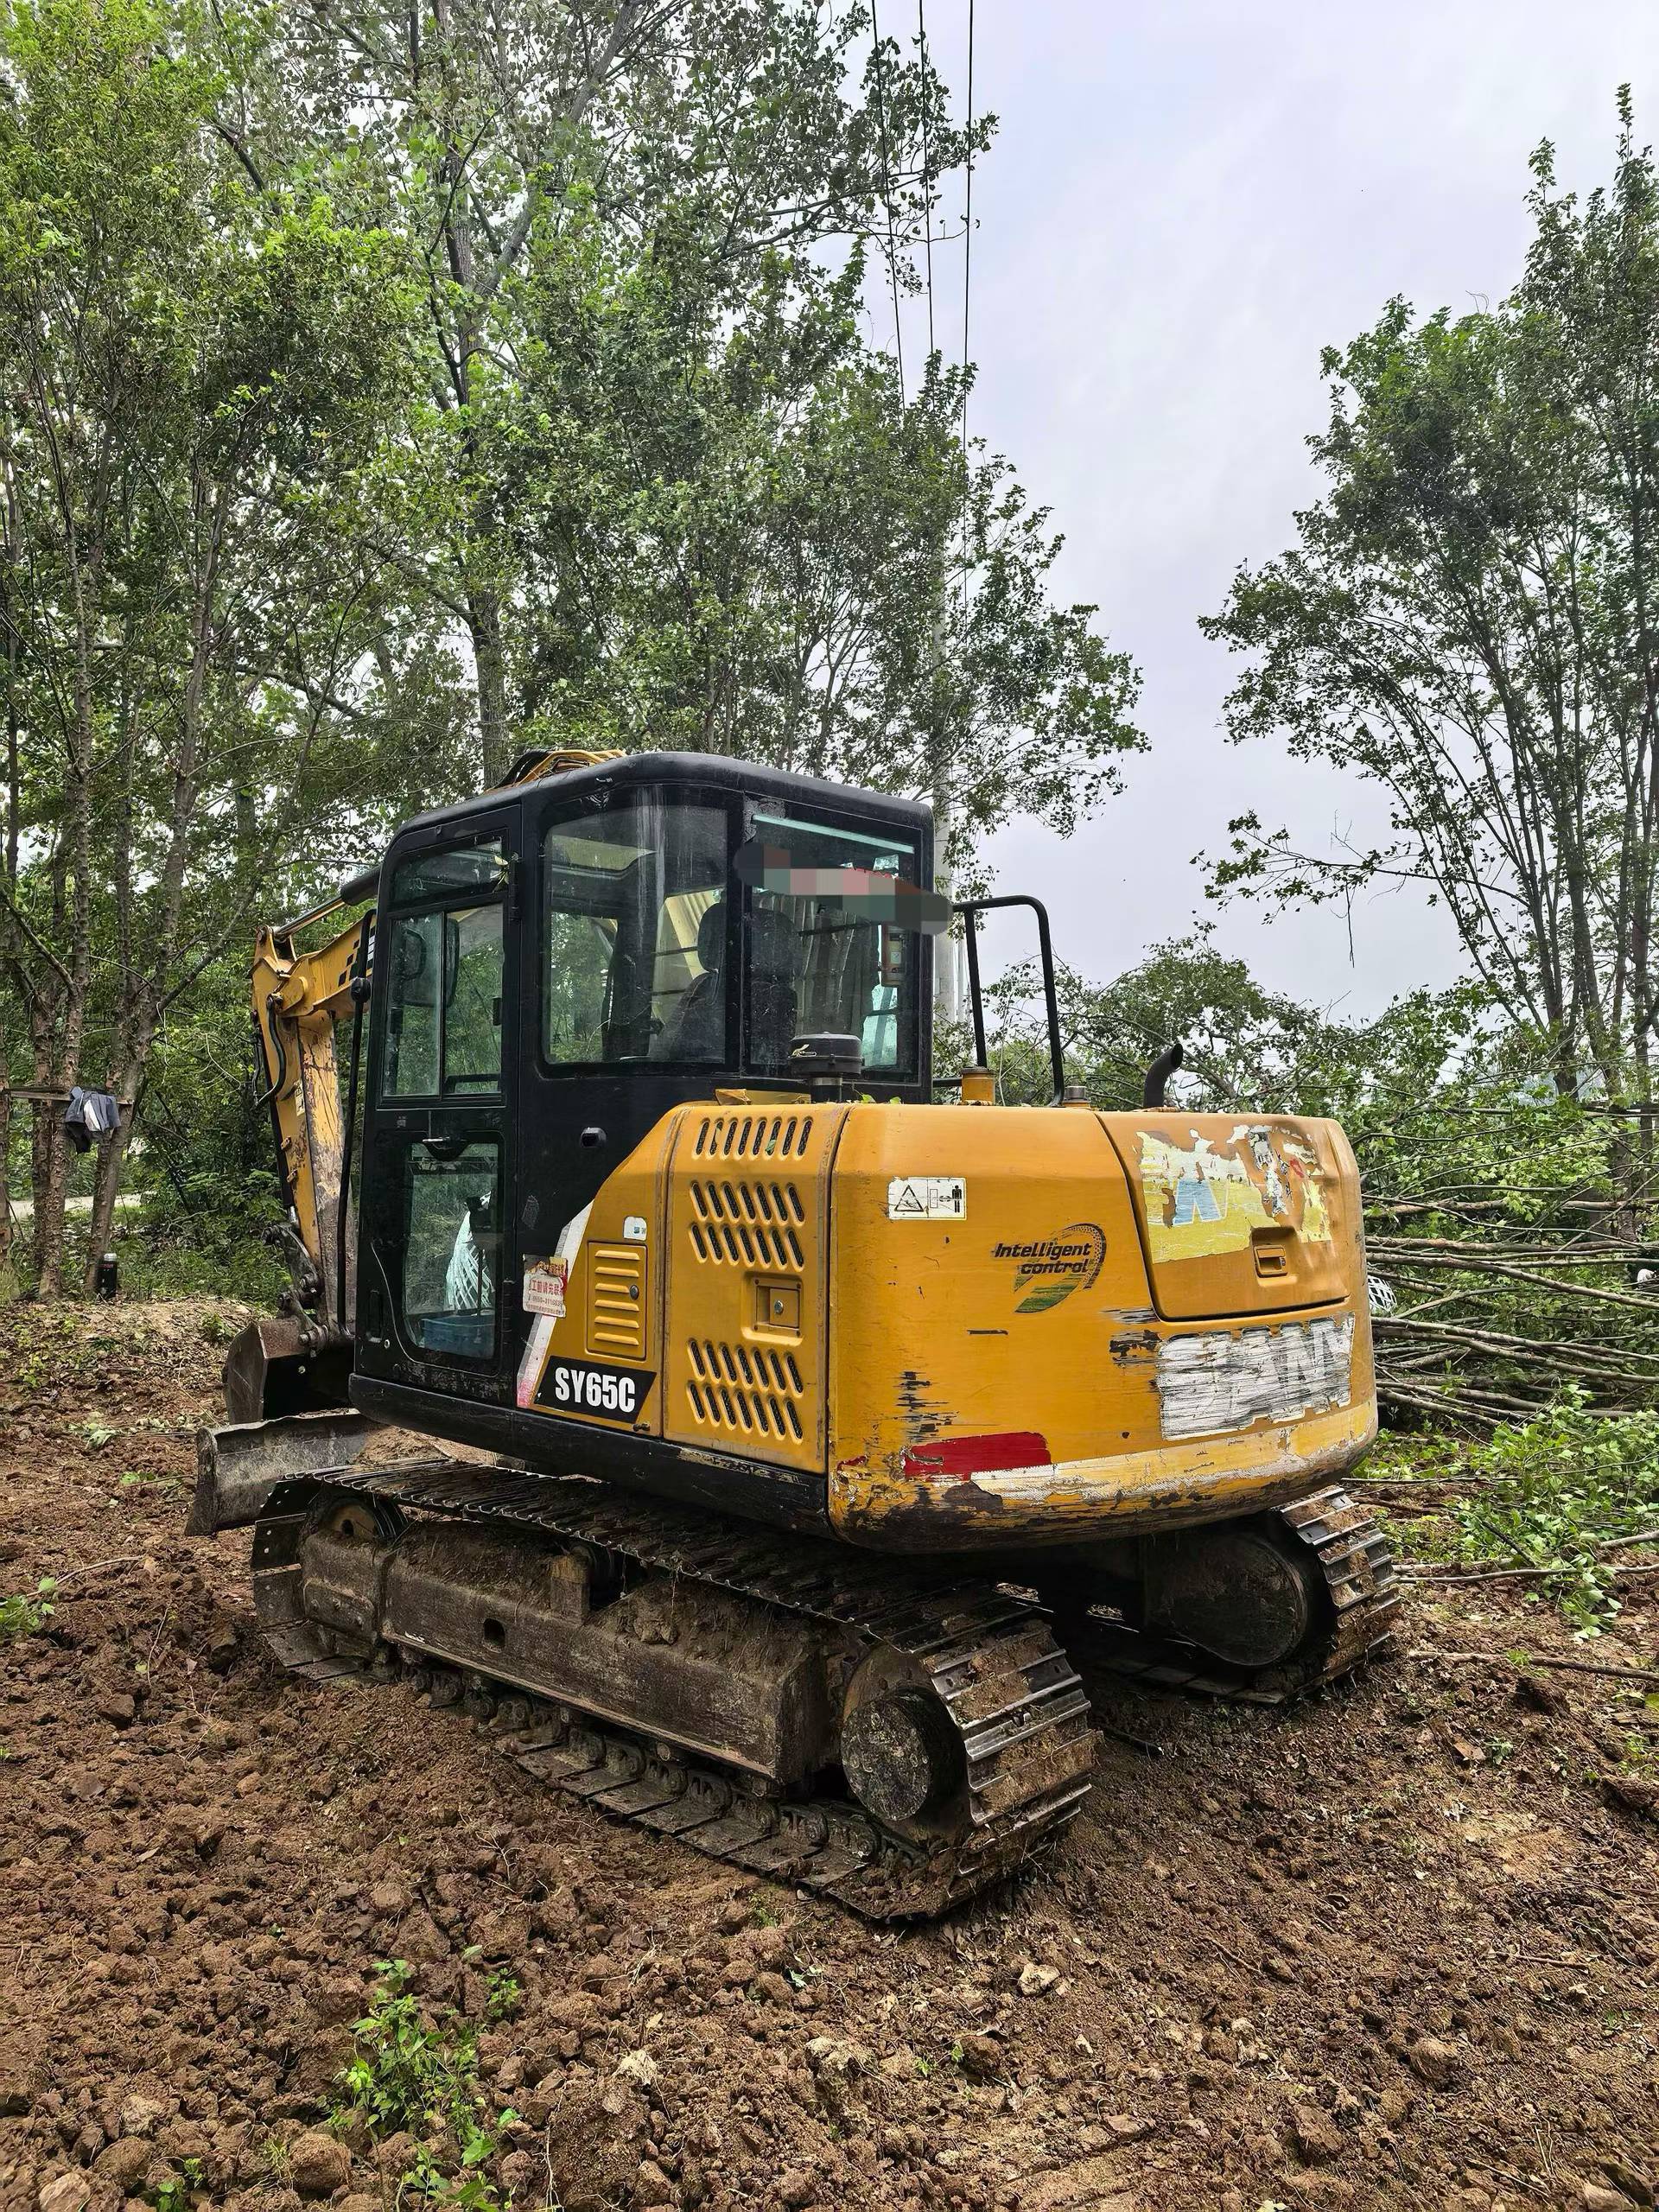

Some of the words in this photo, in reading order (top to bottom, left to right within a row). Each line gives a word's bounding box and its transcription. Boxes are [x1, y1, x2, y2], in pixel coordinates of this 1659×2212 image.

[994, 1242, 1092, 1261] Intelligent
[1020, 1258, 1090, 1274] control
[555, 1367, 635, 1413] SY65C
